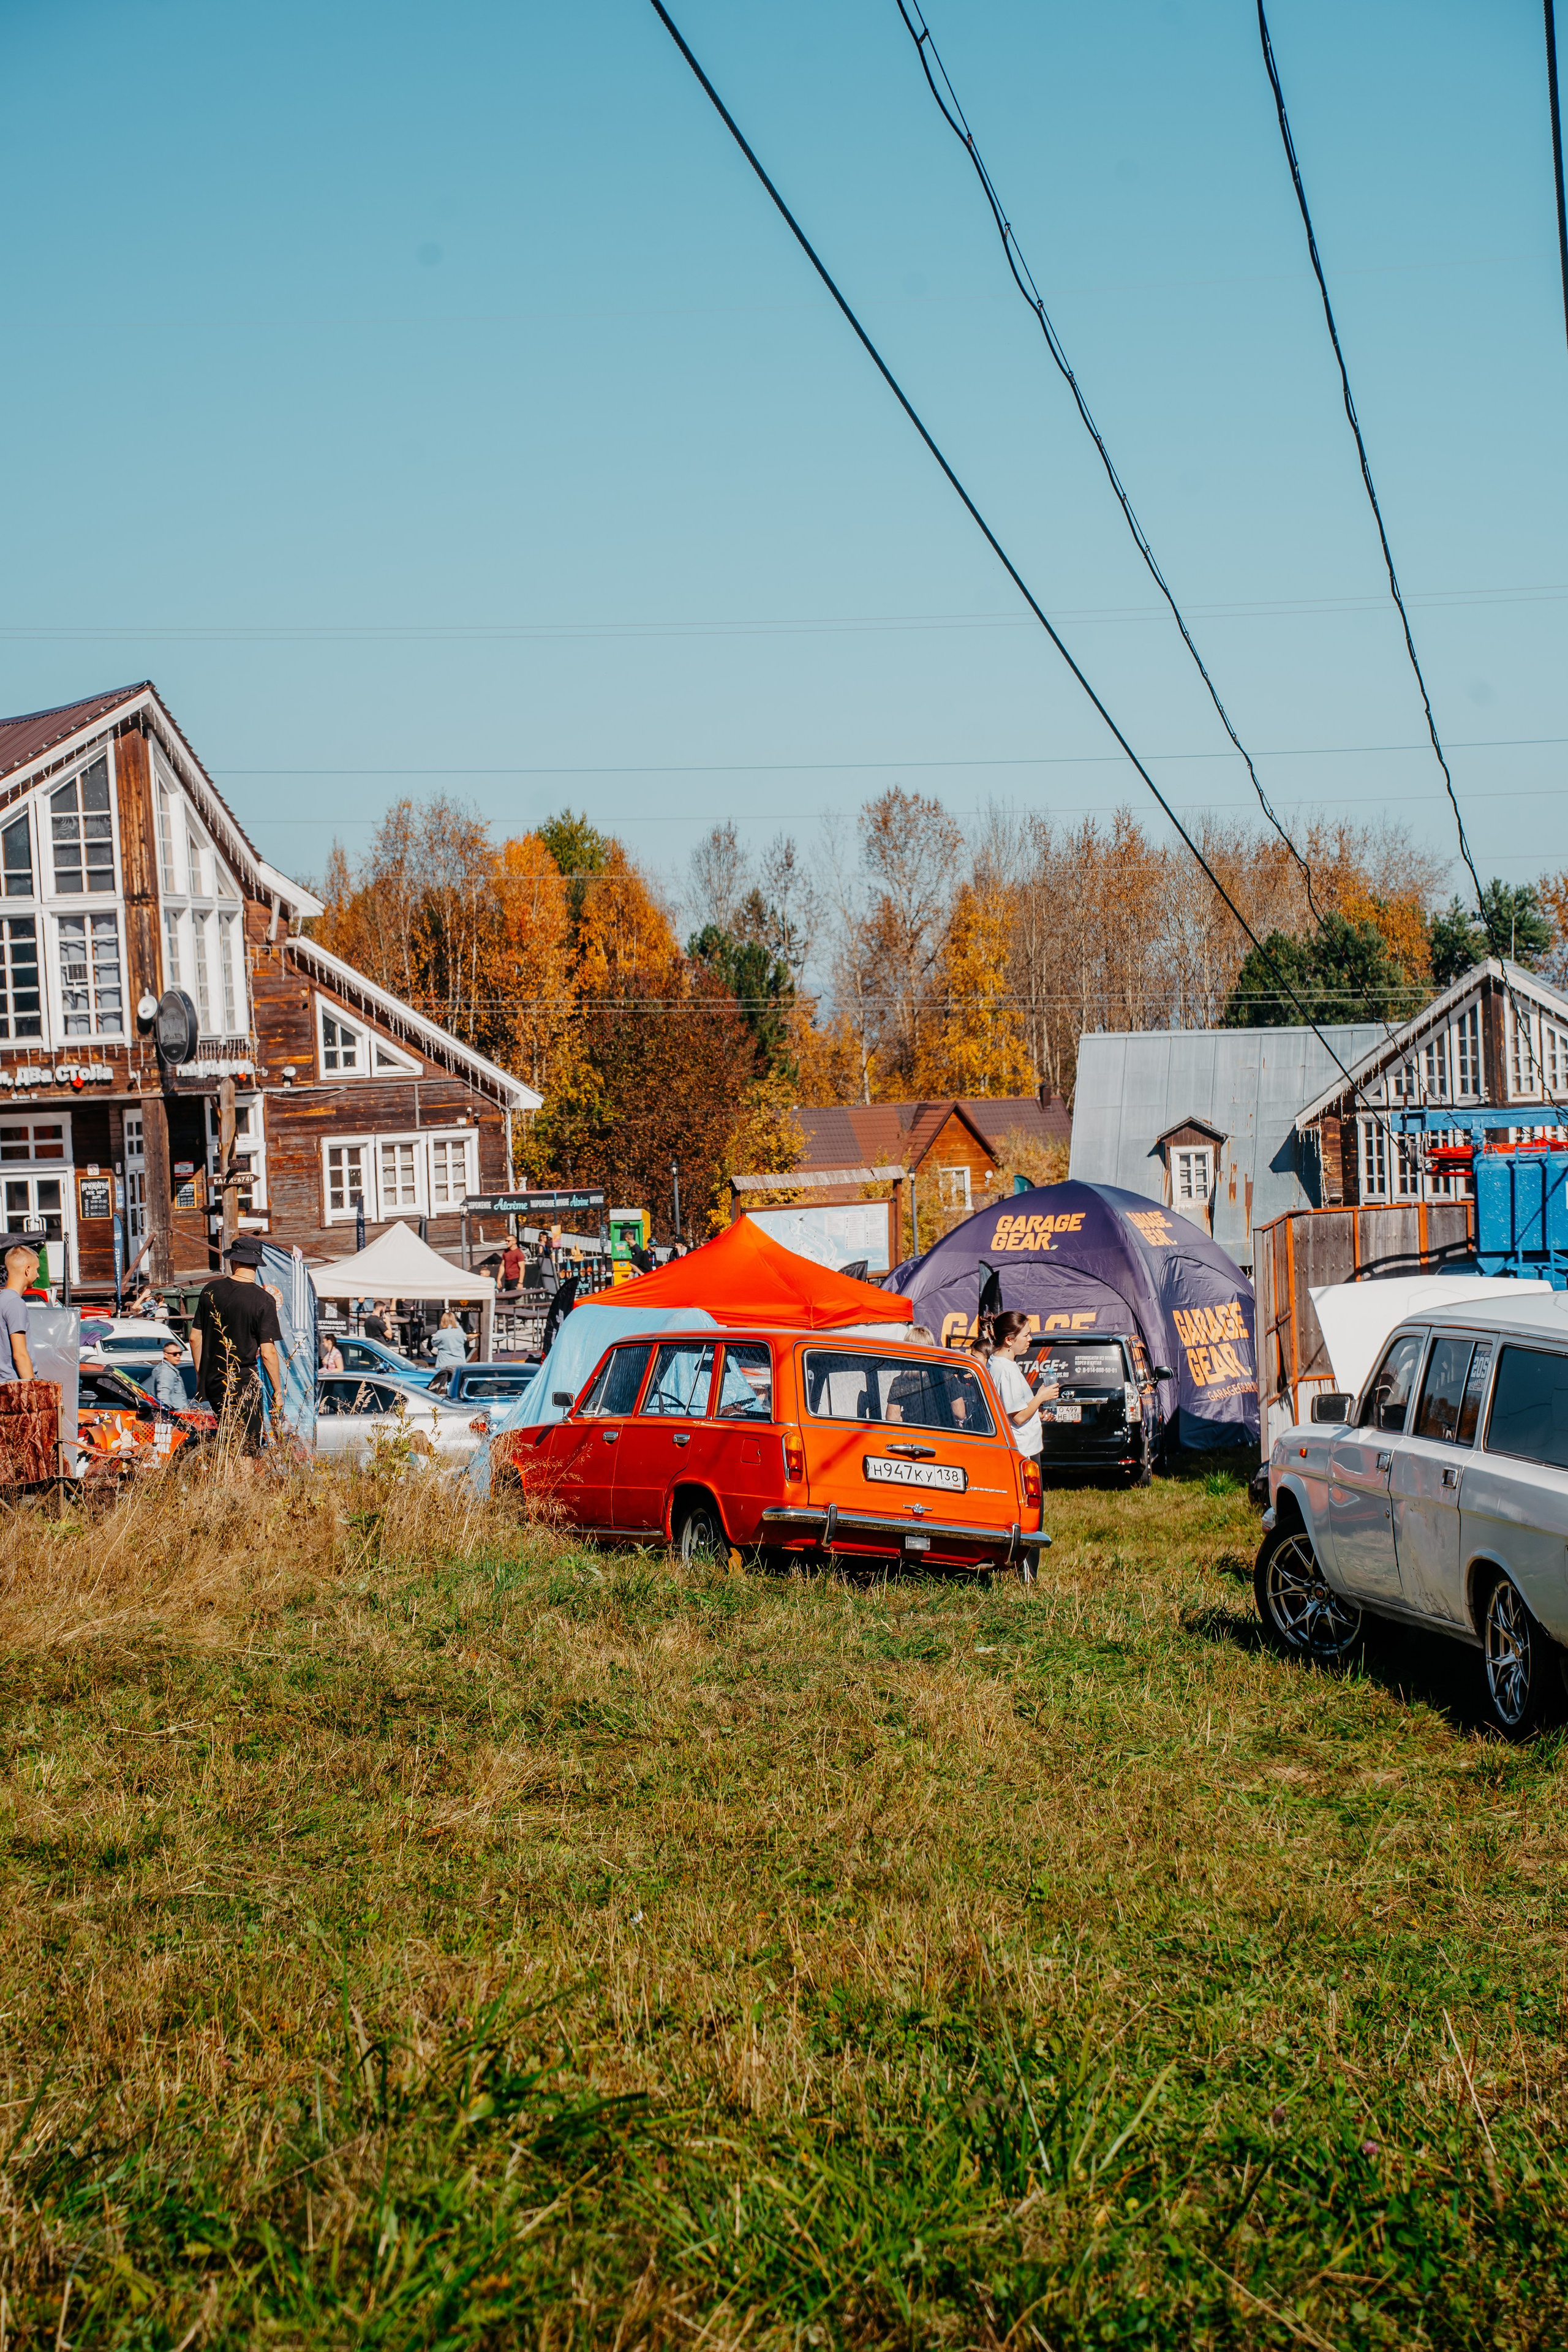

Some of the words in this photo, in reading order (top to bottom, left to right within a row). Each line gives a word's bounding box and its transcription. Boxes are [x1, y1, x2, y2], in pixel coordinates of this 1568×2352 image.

[996, 1213, 1086, 1233] GARAGE
[1125, 1211, 1174, 1229] GARAGE
[1172, 1302, 1249, 1346] GARAGE
[1471, 1356, 1491, 1378] 205
[873, 1463, 932, 1483] Н947КУ
[937, 1469, 959, 1482] 138
